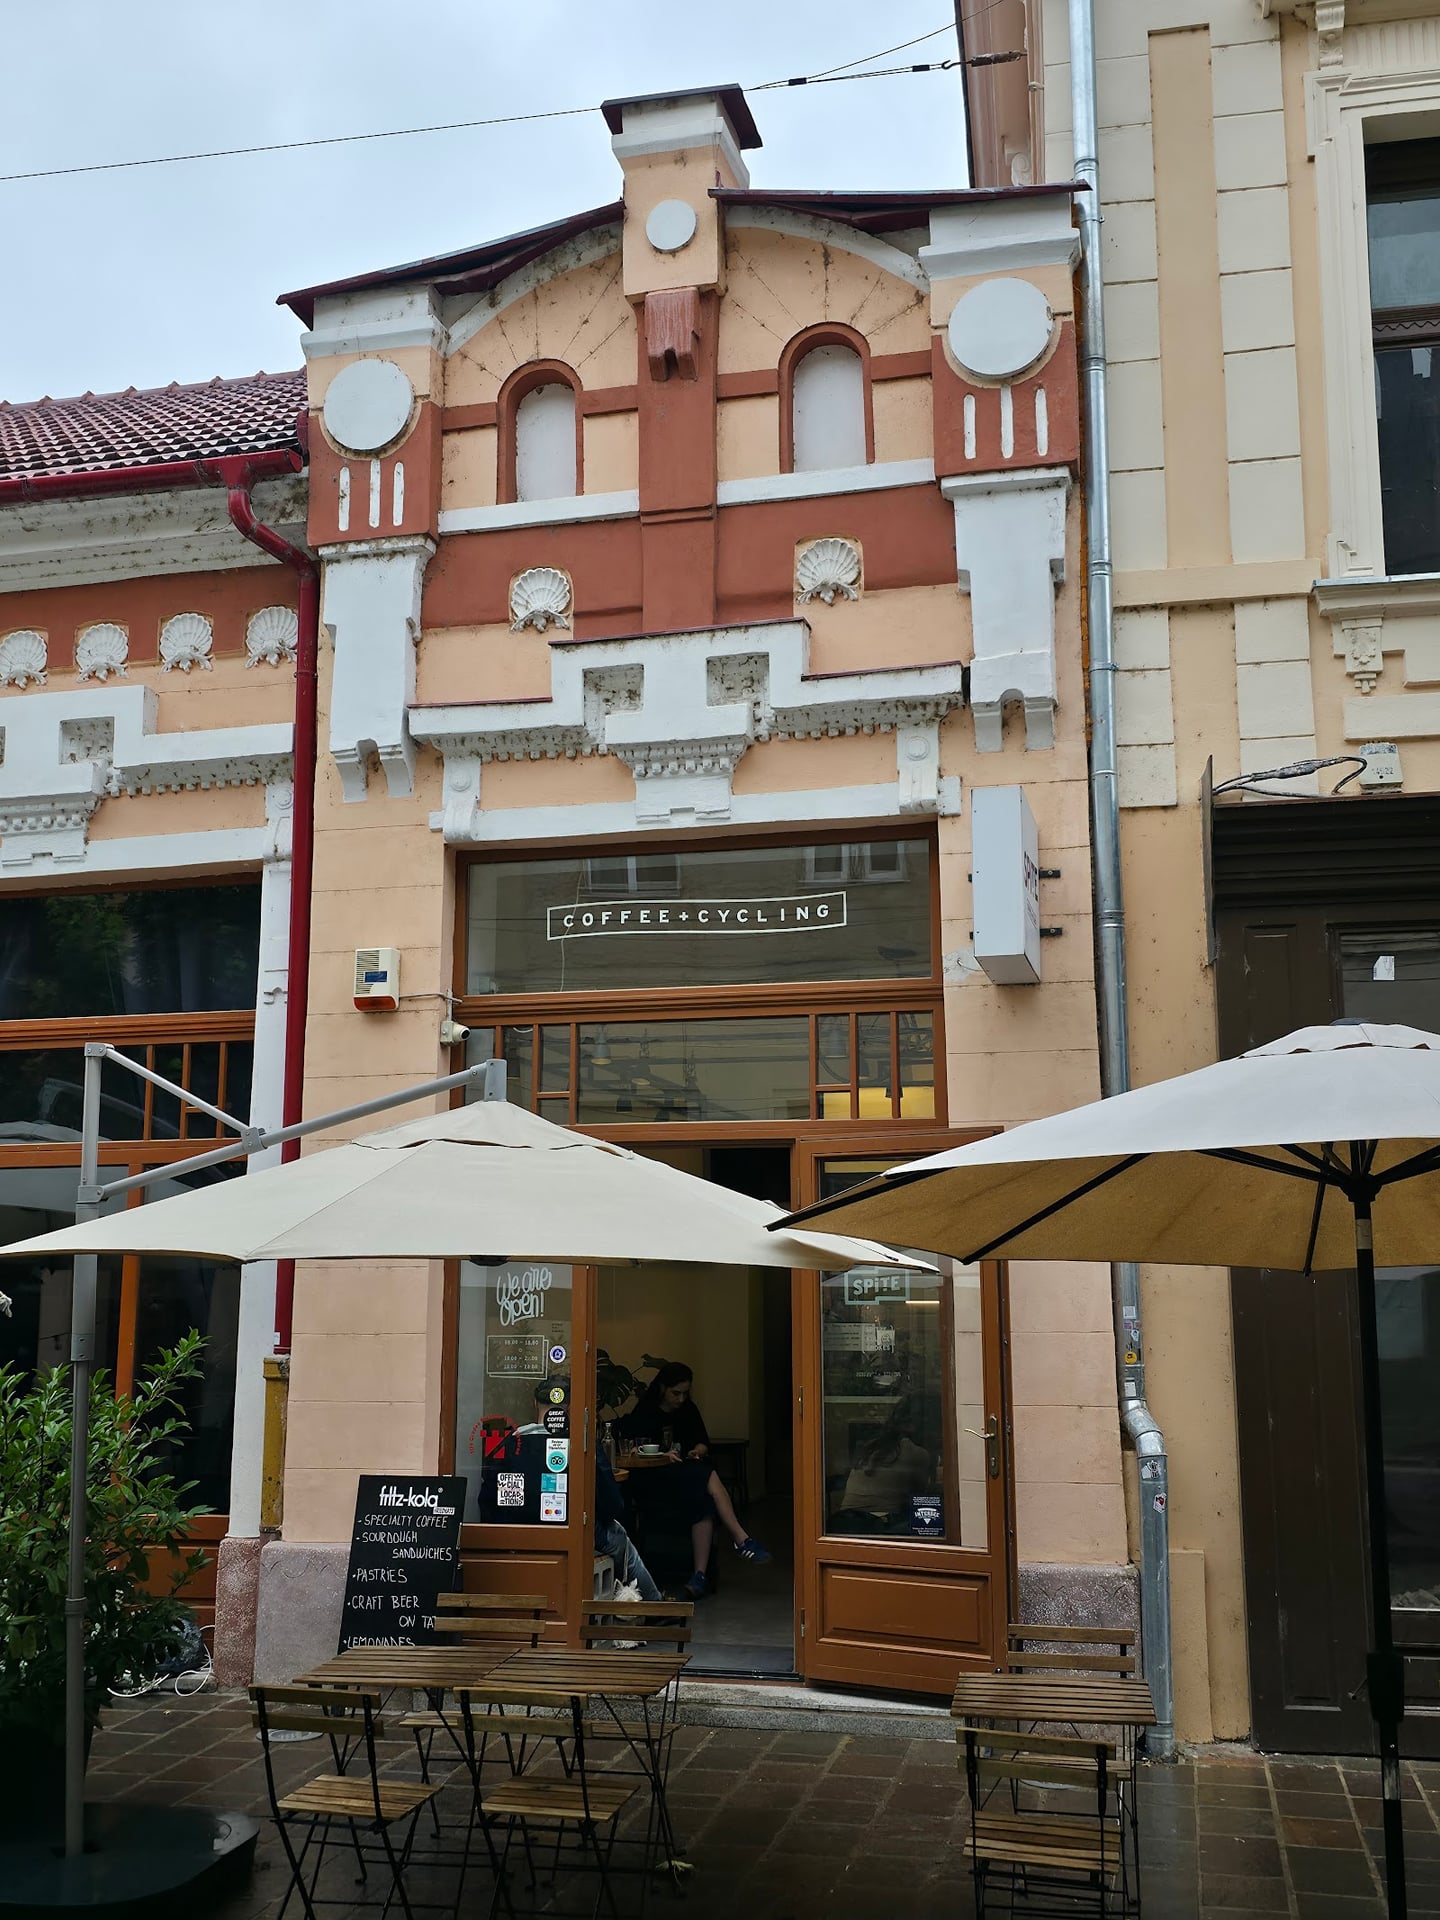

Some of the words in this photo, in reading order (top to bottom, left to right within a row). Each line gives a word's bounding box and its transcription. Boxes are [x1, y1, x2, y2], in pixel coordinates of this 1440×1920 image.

[496, 1271, 521, 1305] We
[521, 1266, 553, 1293] are
[416, 1515, 448, 1529] COFFEE
[351, 1595, 384, 1610] CRAFT
[391, 1595, 420, 1609] BEER
[399, 1615, 416, 1628] ON
